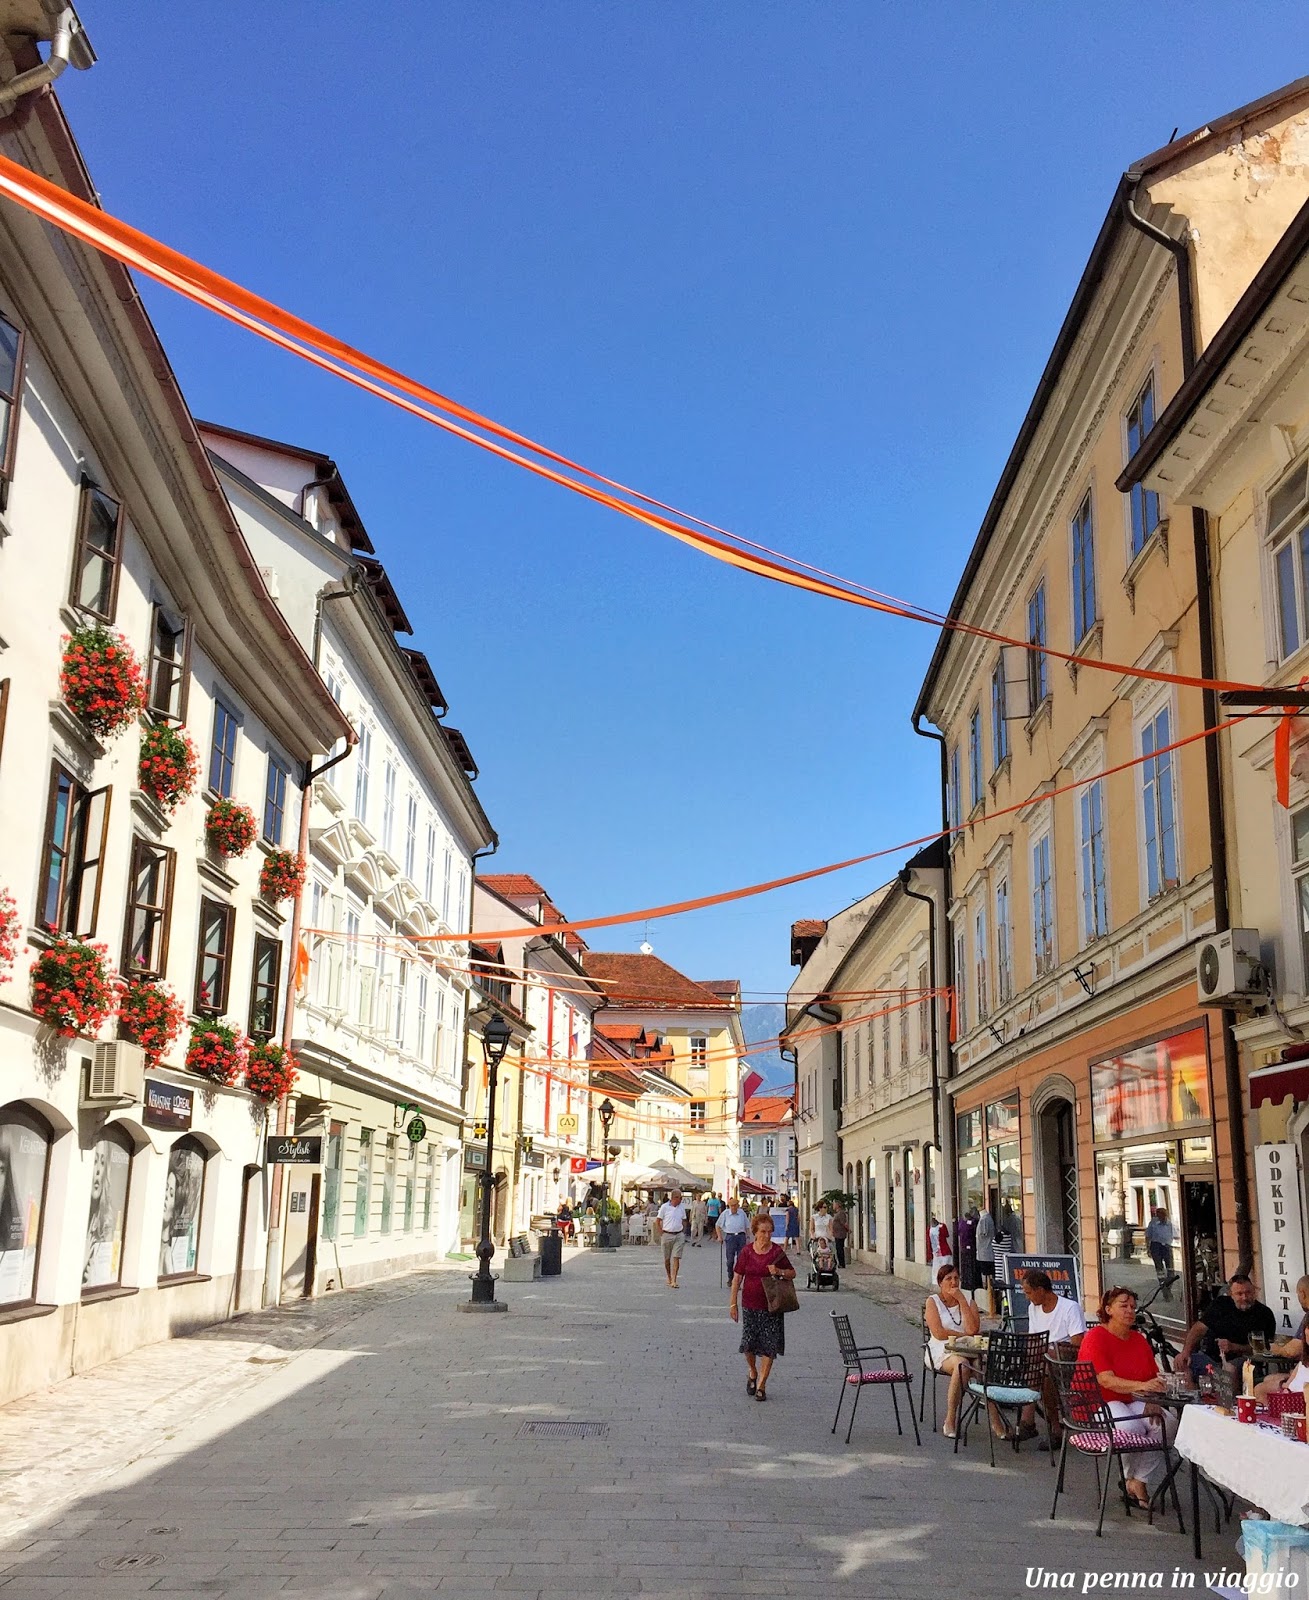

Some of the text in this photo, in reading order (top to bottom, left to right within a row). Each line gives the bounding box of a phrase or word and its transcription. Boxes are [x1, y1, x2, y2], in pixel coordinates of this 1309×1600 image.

[278, 1139, 311, 1159] Stylish
[1268, 1150, 1293, 1329] ODKUP ZLATA
[1021, 1260, 1040, 1268] ARMY
